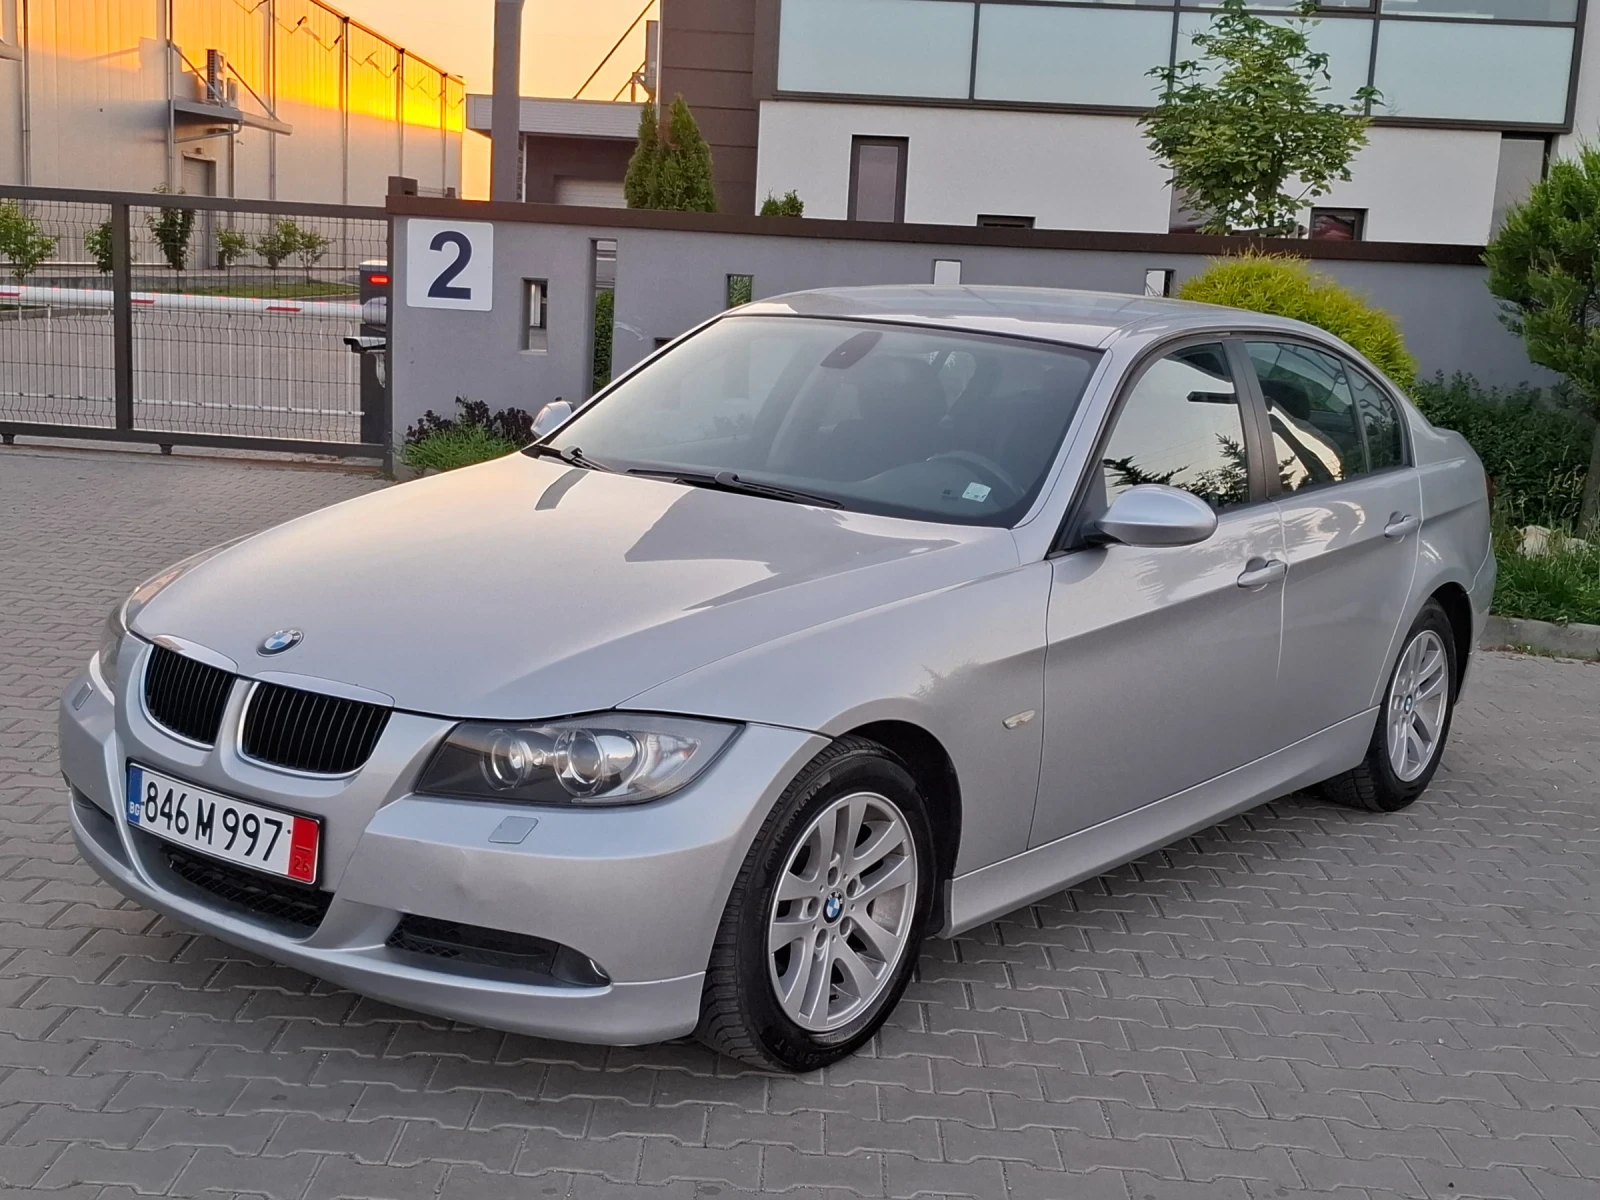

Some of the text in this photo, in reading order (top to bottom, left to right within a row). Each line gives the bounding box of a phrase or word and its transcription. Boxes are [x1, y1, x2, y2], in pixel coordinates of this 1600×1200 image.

[427, 230, 473, 300] 2
[129, 801, 141, 816] BG
[145, 781, 283, 862] 846 M 997
[293, 855, 311, 874] 26
